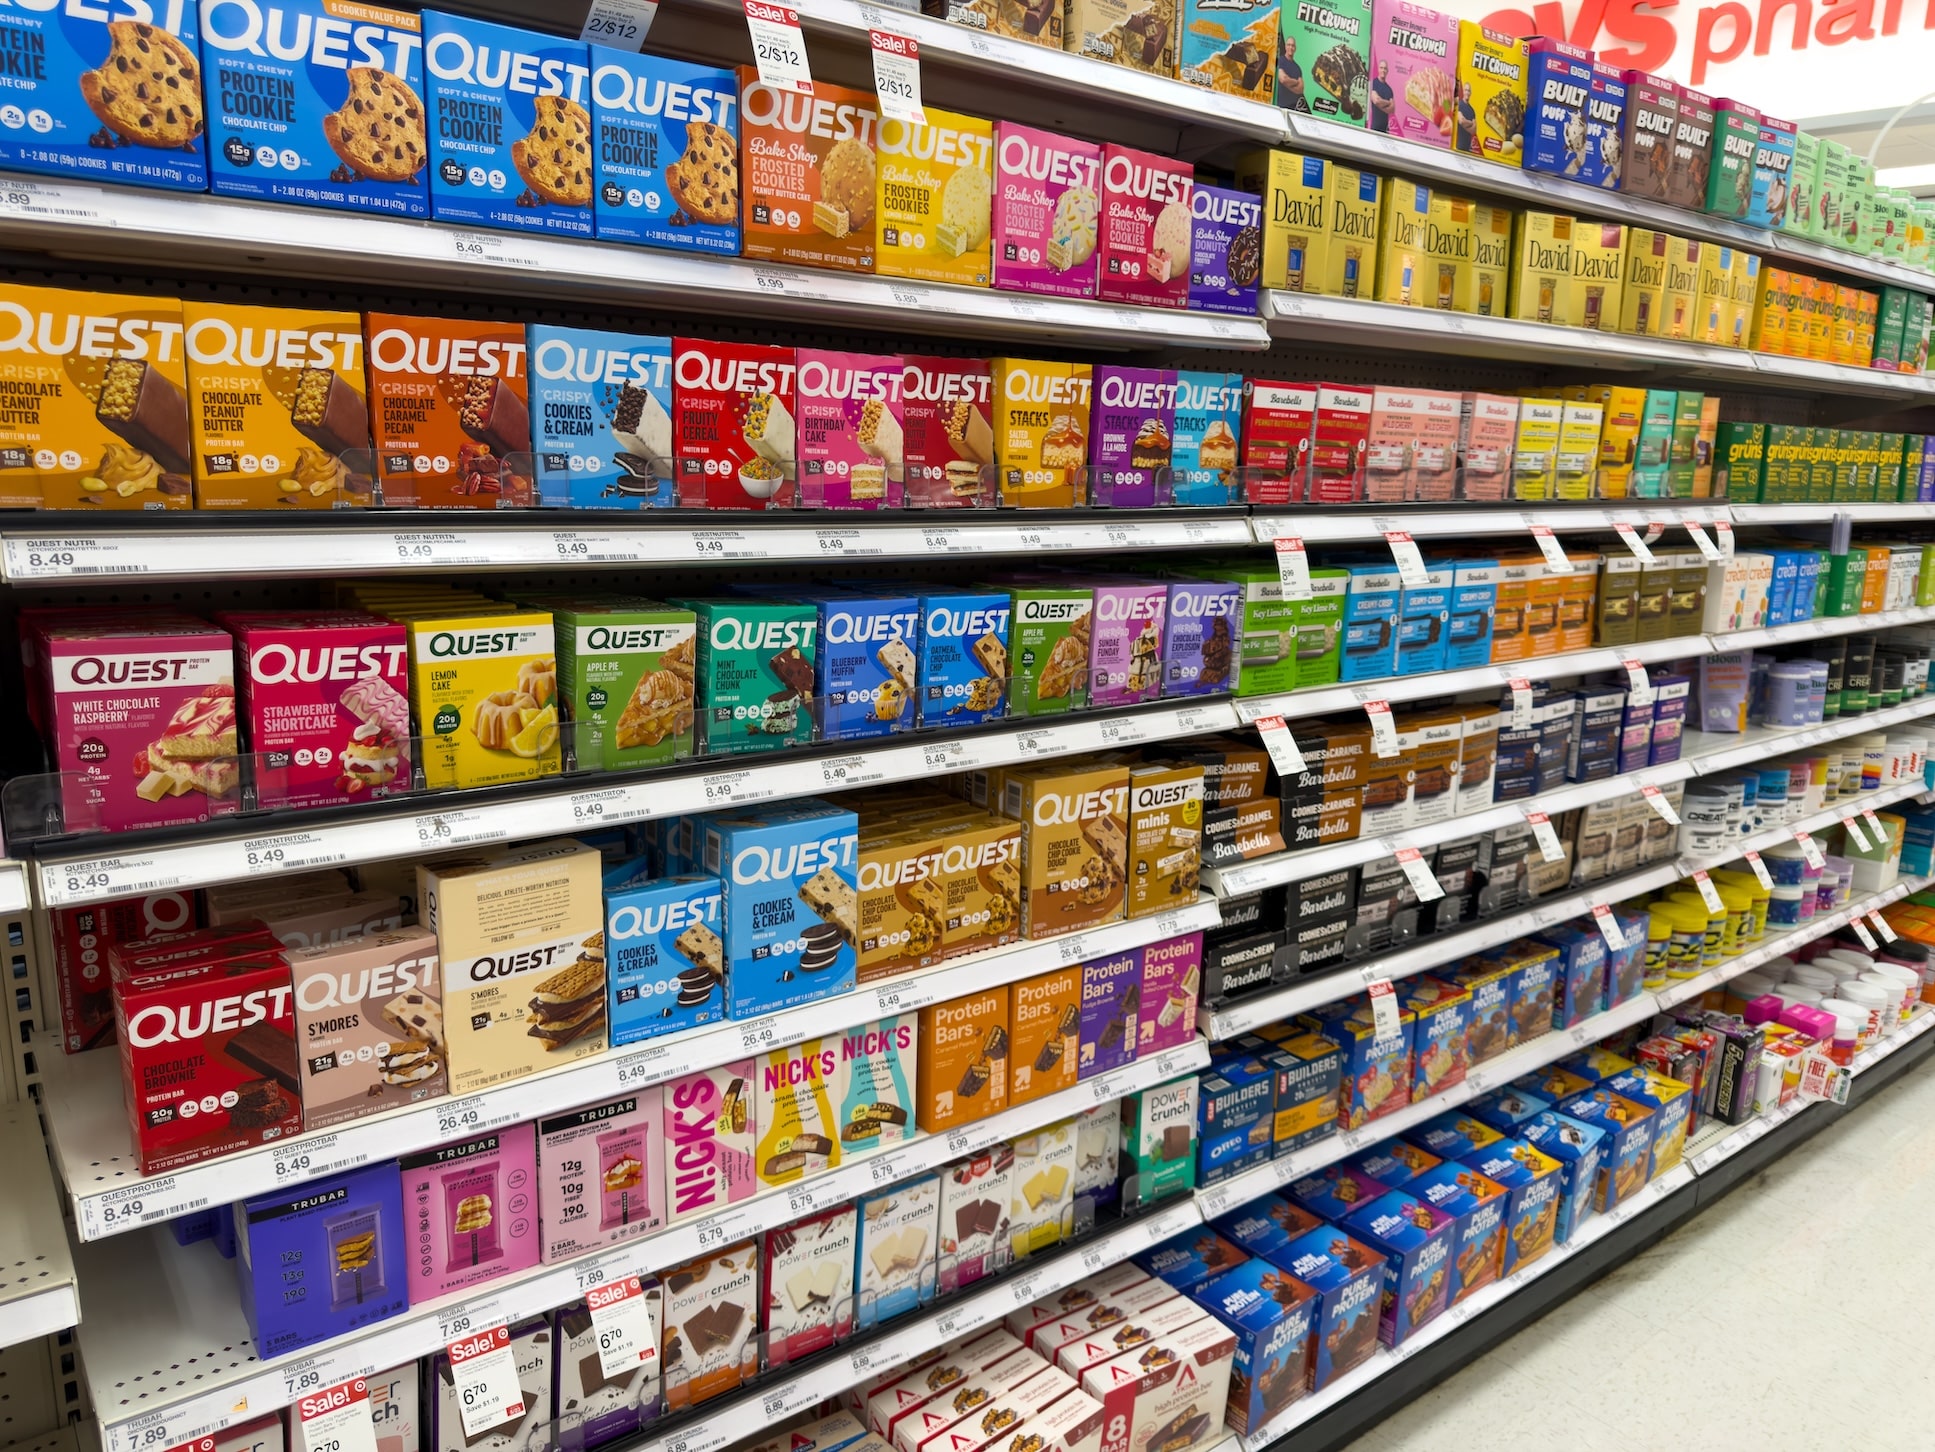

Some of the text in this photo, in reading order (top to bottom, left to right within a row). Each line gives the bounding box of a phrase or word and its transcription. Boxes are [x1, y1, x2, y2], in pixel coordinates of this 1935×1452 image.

[331, 3, 417, 28] 8 COOKIE VALUE PACK
[746, 3, 786, 23] Sale!
[587, 18, 638, 39] 2/$12
[203, 0, 422, 80] QUEST
[758, 44, 799, 66] 2/$12
[1556, 41, 1586, 59] VALUE PACK
[218, 58, 294, 77] SOFT & CHEWY
[427, 33, 589, 98] QUEST
[219, 70, 295, 96] PROTEIN
[878, 77, 913, 98] 2/$12
[1543, 79, 1588, 107] BUILT
[222, 93, 296, 123] COOKIE
[742, 81, 877, 146] QUEST
[222, 116, 288, 133] CHOCOLATE CHIP
[1636, 109, 1674, 135] BUILT
[21, 149, 107, 169] 8 2.08 OZ (59g) COOKIES
[229, 144, 250, 157] 15g
[750, 137, 817, 168] Bake Shop
[112, 162, 182, 181] NET WT 1.04 LB (472g)
[752, 156, 804, 177] FROSTED
[752, 171, 805, 191] COOKIES
[1104, 156, 1193, 206] QUEST
[752, 186, 811, 201] PEANUT BUTTER CAKE
[1192, 191, 1261, 228] QUEST
[1274, 189, 1324, 229] David
[456, 241, 483, 255] 8.49
[1195, 239, 1226, 252] DONUTS
[1528, 241, 1570, 271] David
[757, 277, 784, 289] 8.99
[186, 318, 362, 370] QUEST
[535, 340, 672, 388] QUEST
[675, 351, 795, 395] QUEST
[200, 376, 262, 391] CRISPY
[202, 392, 262, 406] CHOCOLATE
[1270, 394, 1302, 406] Barebells
[203, 405, 245, 419] PEANUT
[384, 410, 427, 422] CARAMEL
[544, 403, 592, 421] COOKIES
[683, 411, 718, 427] FRUITY
[1010, 410, 1049, 428] STACKS
[203, 418, 243, 432] BUTTER
[384, 423, 415, 434] PECAN
[544, 420, 593, 437] & CREAM
[683, 426, 719, 441] CEREAL
[805, 418, 845, 432] BIRTHDAY
[205, 439, 230, 447] PROTEIN
[805, 430, 826, 443] CAKE
[1008, 438, 1033, 449] CARAMEL
[1009, 429, 1028, 440] SALTED
[211, 456, 232, 467] 18g
[27, 539, 96, 548] QUEST NUTRI
[398, 544, 432, 557] 8.49
[557, 543, 588, 554] 8.49
[696, 540, 723, 552] 9.49
[1275, 540, 1297, 551] Sale!
[29, 552, 74, 567] 8.49
[1748, 565, 1772, 581] create
[1253, 607, 1294, 620] Key Lime Pie
[430, 632, 518, 656] QUEST
[1098, 639, 1119, 648] SUNDAE
[1098, 648, 1119, 657] FUNDAY
[1172, 642, 1200, 651] EXPLOSION
[586, 662, 619, 672] APPLE PIE
[717, 660, 735, 670] MINT
[831, 656, 867, 668] BLUEBERRY
[71, 658, 187, 685] QUEST
[431, 670, 458, 681] LEMON
[716, 669, 757, 680] CHOCOLATE
[831, 666, 855, 677] MUFFIN
[431, 680, 451, 691] CAKE
[716, 680, 741, 691] CHUNK
[72, 697, 160, 713] WHITE CHOCOLATE
[263, 703, 337, 718] STRAWBERRY
[73, 710, 129, 724] RASPBERRY
[264, 716, 337, 733] SHORTCAKE
[82, 743, 104, 754] 20g
[574, 803, 603, 817] 8.49
[1137, 812, 1170, 830] minis
[1213, 832, 1271, 859] Barebells
[65, 859, 121, 872] QUEST BAR
[247, 849, 285, 865] 8.49
[67, 873, 110, 892] 8.49
[504, 882, 544, 896] ATHLETE-WORTHY
[545, 877, 569, 887] NUTRITION
[862, 914, 882, 925] DOUGH
[128, 985, 292, 1048] QUEST
[935, 997, 997, 1027] Protein
[1435, 1007, 1458, 1025] PURE
[308, 1015, 359, 1036] S'MORES
[935, 1022, 974, 1044] Bars
[1428, 1015, 1463, 1039] PROTEIN
[144, 1055, 206, 1078] CHOCOLATE
[1808, 1060, 1826, 1078] FREE
[145, 1070, 196, 1090] BROWNIE
[770, 1082, 829, 1104] caramel chocolate
[1151, 1086, 1192, 1109] power
[1215, 1080, 1269, 1112] BUILDERS
[1717, 1075, 1737, 1116] ENERGY
[439, 1111, 478, 1130] 26.49
[579, 1101, 634, 1123] TRUBAR
[1151, 1101, 1190, 1122] crunch
[273, 1135, 338, 1157] QUESTPROTBAR
[949, 1138, 968, 1151] 6.99
[1211, 1136, 1242, 1158] OREO
[275, 1156, 311, 1175] 8.49
[561, 1161, 582, 1172] 12g
[101, 1178, 175, 1202] QUESTPROTBAR
[291, 1190, 346, 1211] TRUBAR
[711, 1273, 750, 1296] crunch
[1272, 1311, 1303, 1340] PURE
[450, 1336, 495, 1362] Sale!
[1263, 1324, 1310, 1359] PROTEIN
[466, 1396, 500, 1414] Save $1.19
[765, 1400, 783, 1414] 6.89
[128, 1427, 167, 1449] 7.89
